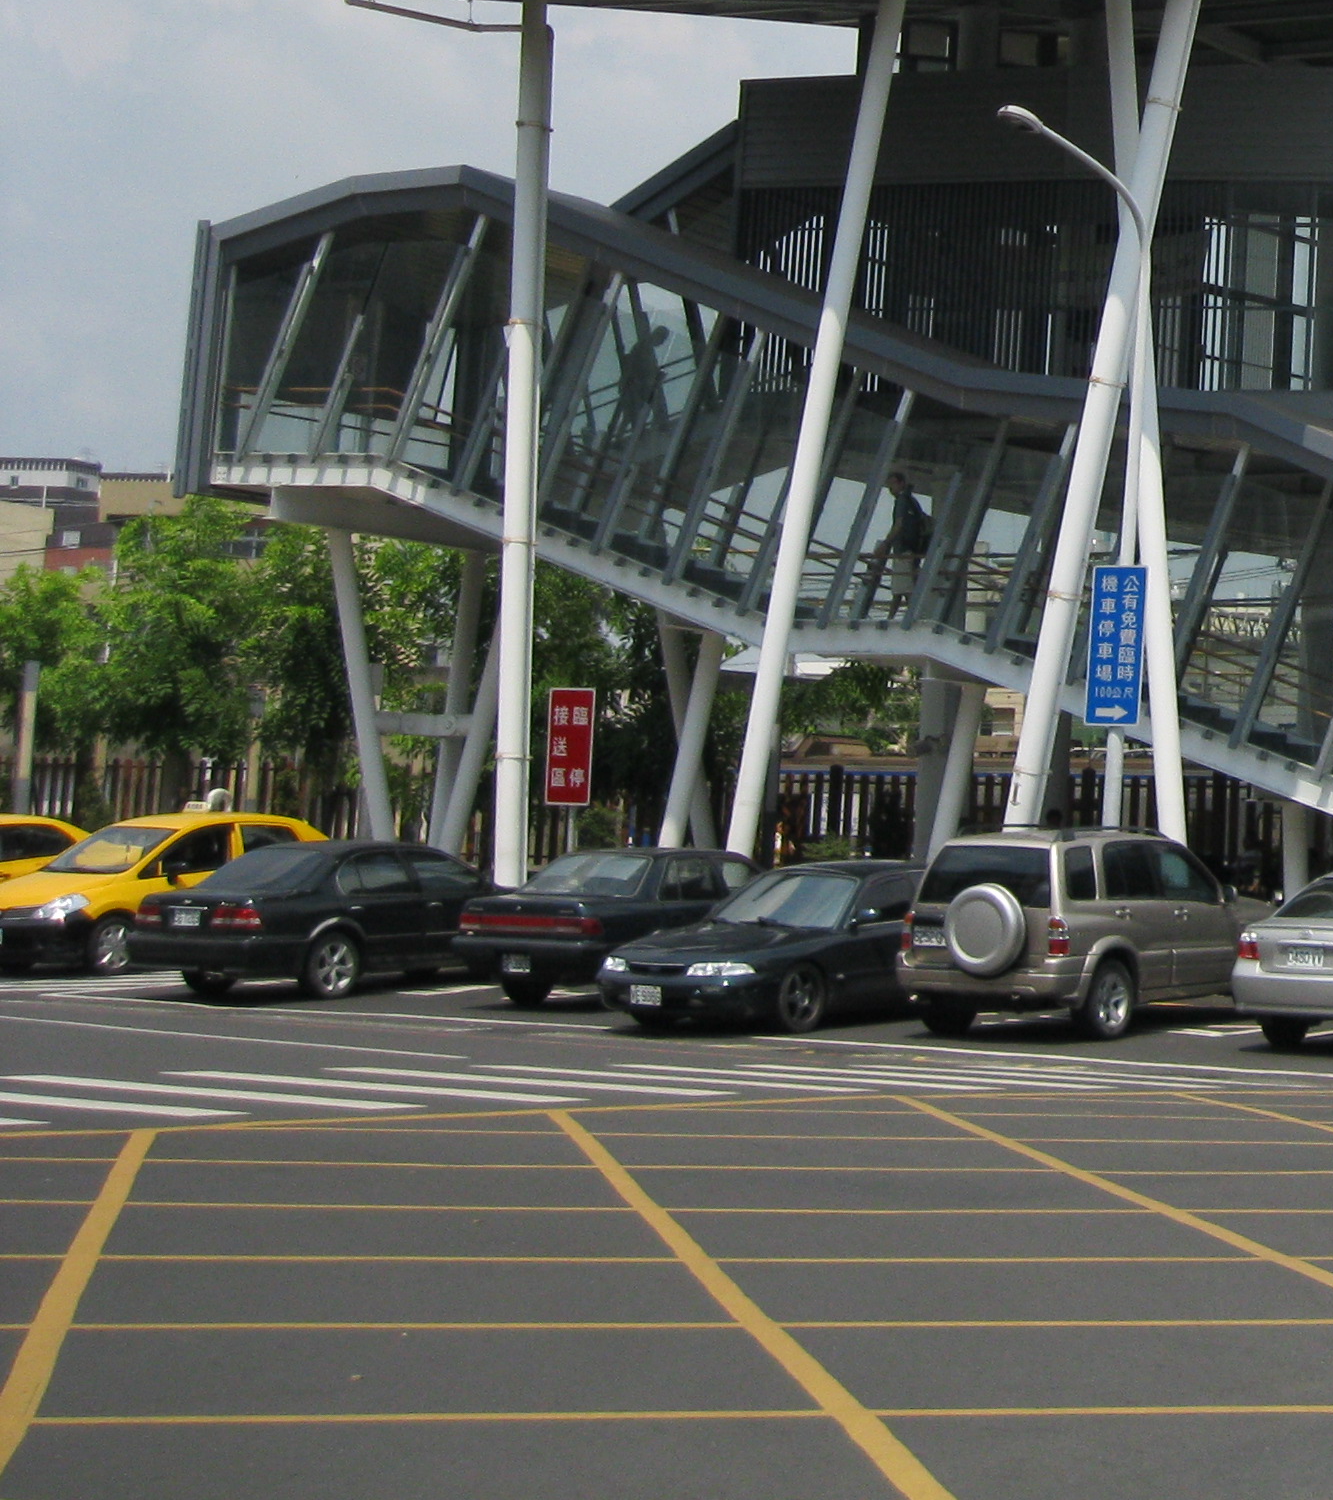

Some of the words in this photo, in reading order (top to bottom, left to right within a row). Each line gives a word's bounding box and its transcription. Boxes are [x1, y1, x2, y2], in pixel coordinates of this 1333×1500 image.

[1095, 575, 1119, 682] 機車停車場
[1117, 575, 1140, 682] 公有免費臨時
